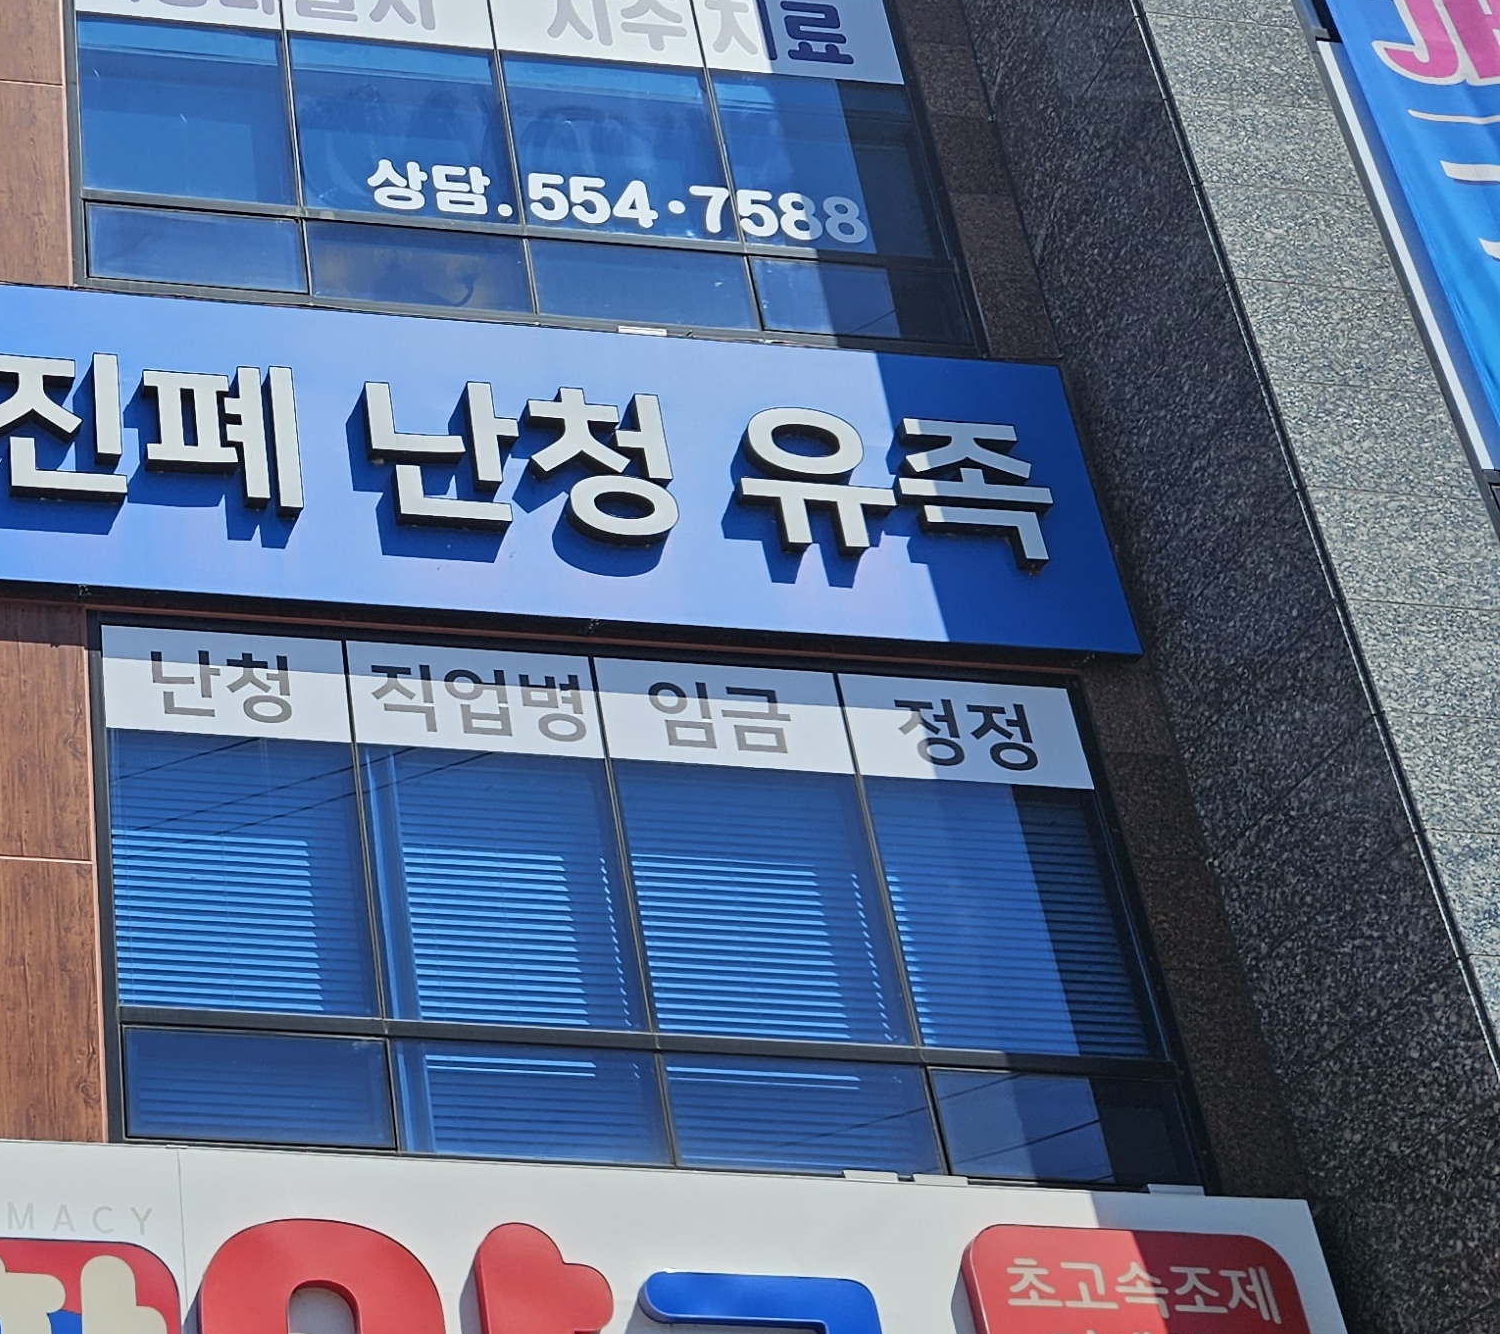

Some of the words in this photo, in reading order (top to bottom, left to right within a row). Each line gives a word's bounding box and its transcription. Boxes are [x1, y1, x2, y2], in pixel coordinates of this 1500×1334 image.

[363, 379, 681, 548] 난청
[736, 405, 1055, 573] 유족
[150, 649, 295, 723] 난청
[370, 662, 588, 743] 직업병
[647, 680, 792, 754] 임금
[895, 697, 1040, 771] 정정
[1005, 1257, 1283, 1325] 초고속조제
